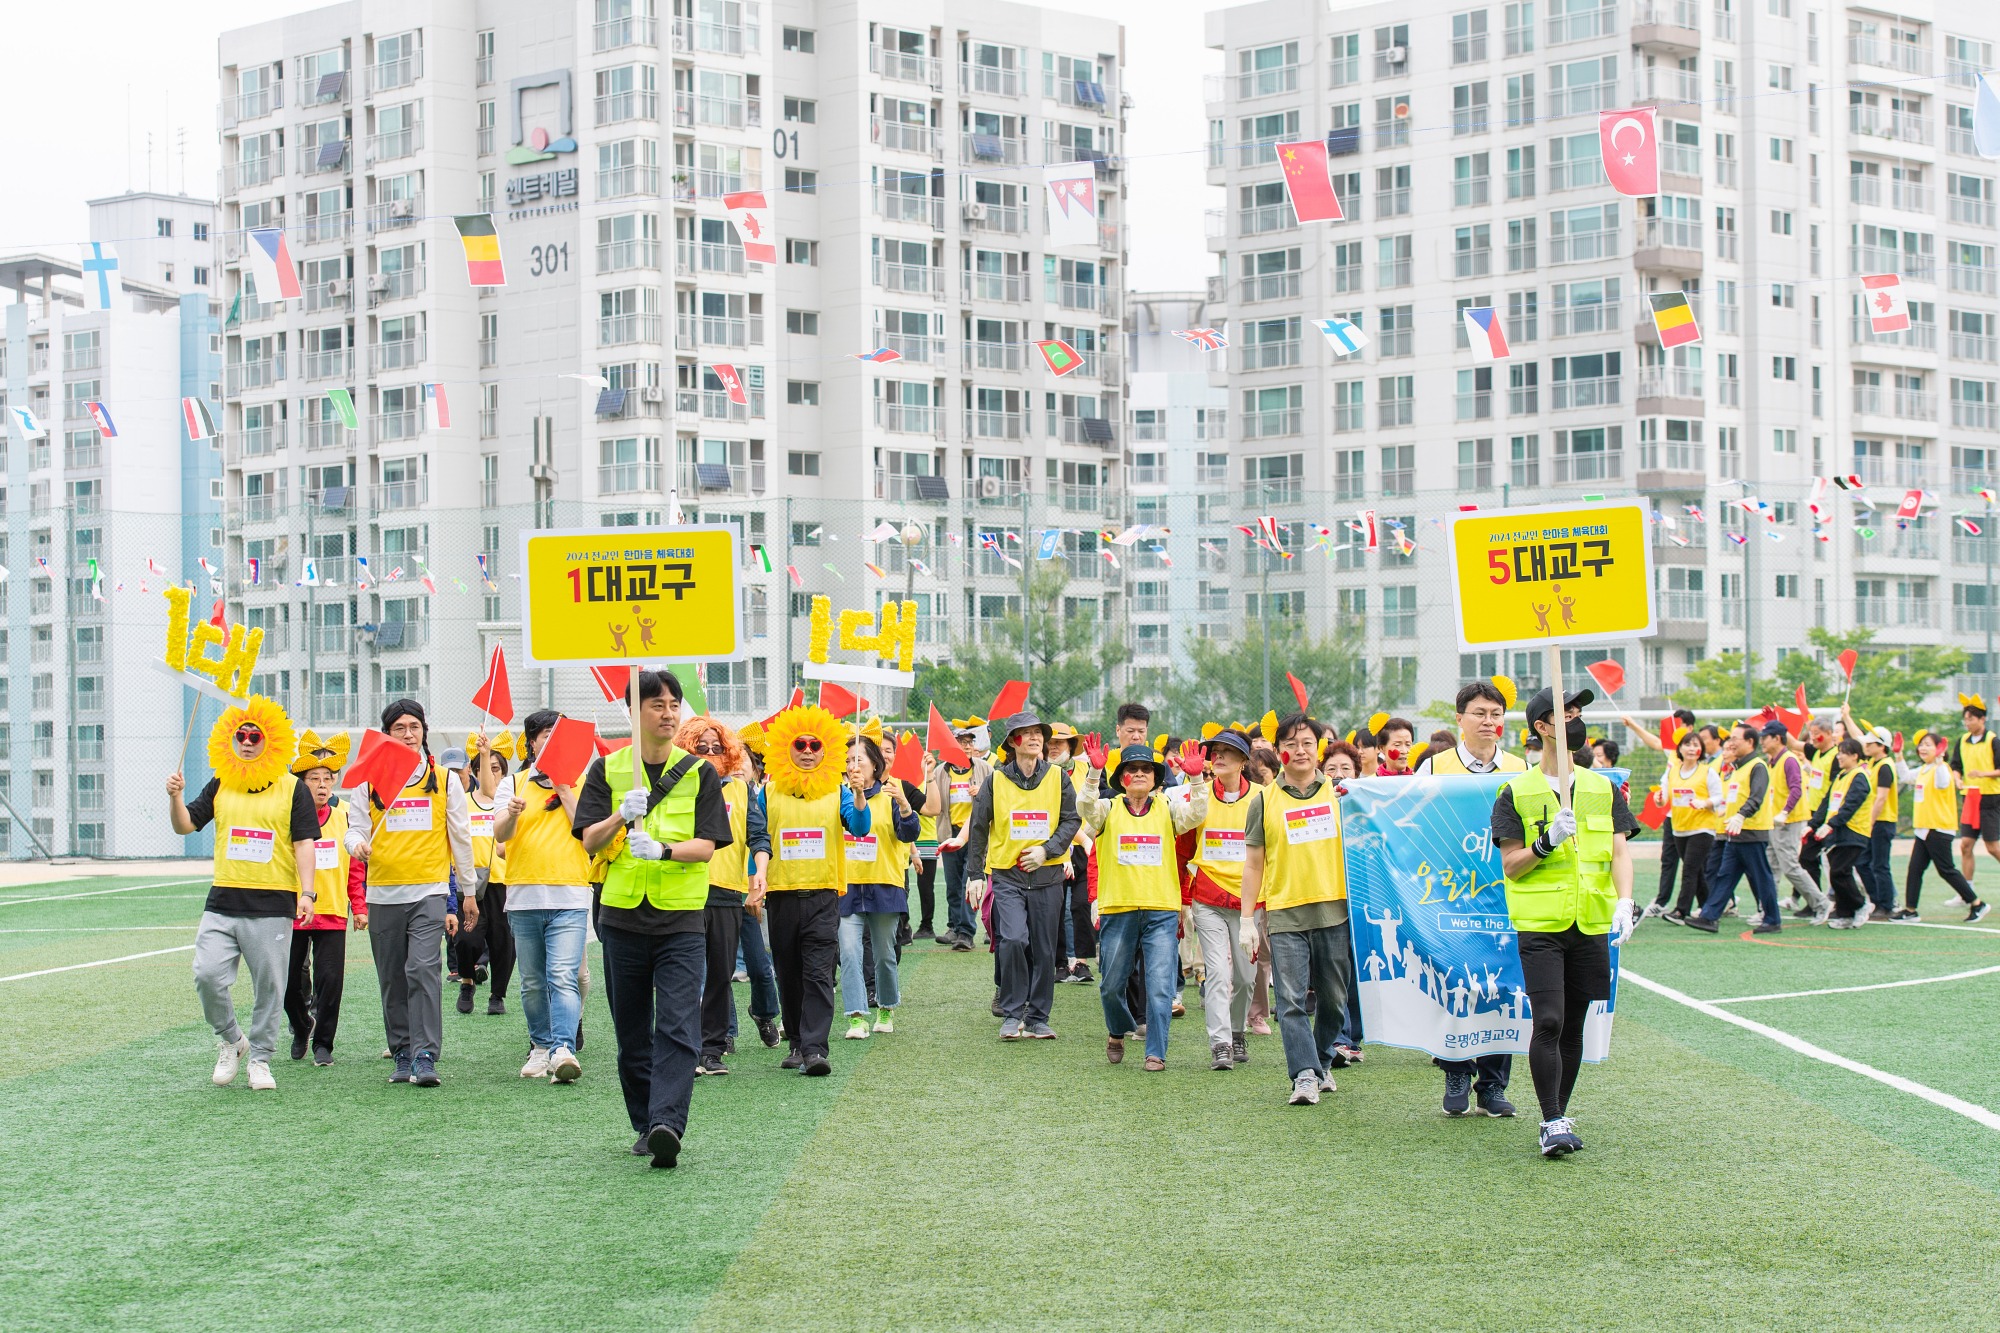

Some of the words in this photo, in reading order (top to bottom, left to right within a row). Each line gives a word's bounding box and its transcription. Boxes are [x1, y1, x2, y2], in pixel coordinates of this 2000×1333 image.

[506, 168, 579, 206] 센트레빌
[530, 241, 568, 277] 301
[1489, 532, 1511, 543] 2024
[1512, 530, 1539, 542] 전교인
[1542, 527, 1569, 540] 한마음
[1572, 524, 1608, 537] 체육대회
[565, 551, 589, 561] 2024
[591, 550, 619, 561] 전교인
[623, 549, 654, 561] 한마음
[656, 547, 695, 560] 체육대회
[1488, 539, 1615, 585] 5대교구
[567, 563, 696, 603] 1대교구
[1450, 917, 1482, 929] We're
[1484, 918, 1504, 930] the
[1445, 1028, 1520, 1049] 은평성결교회
